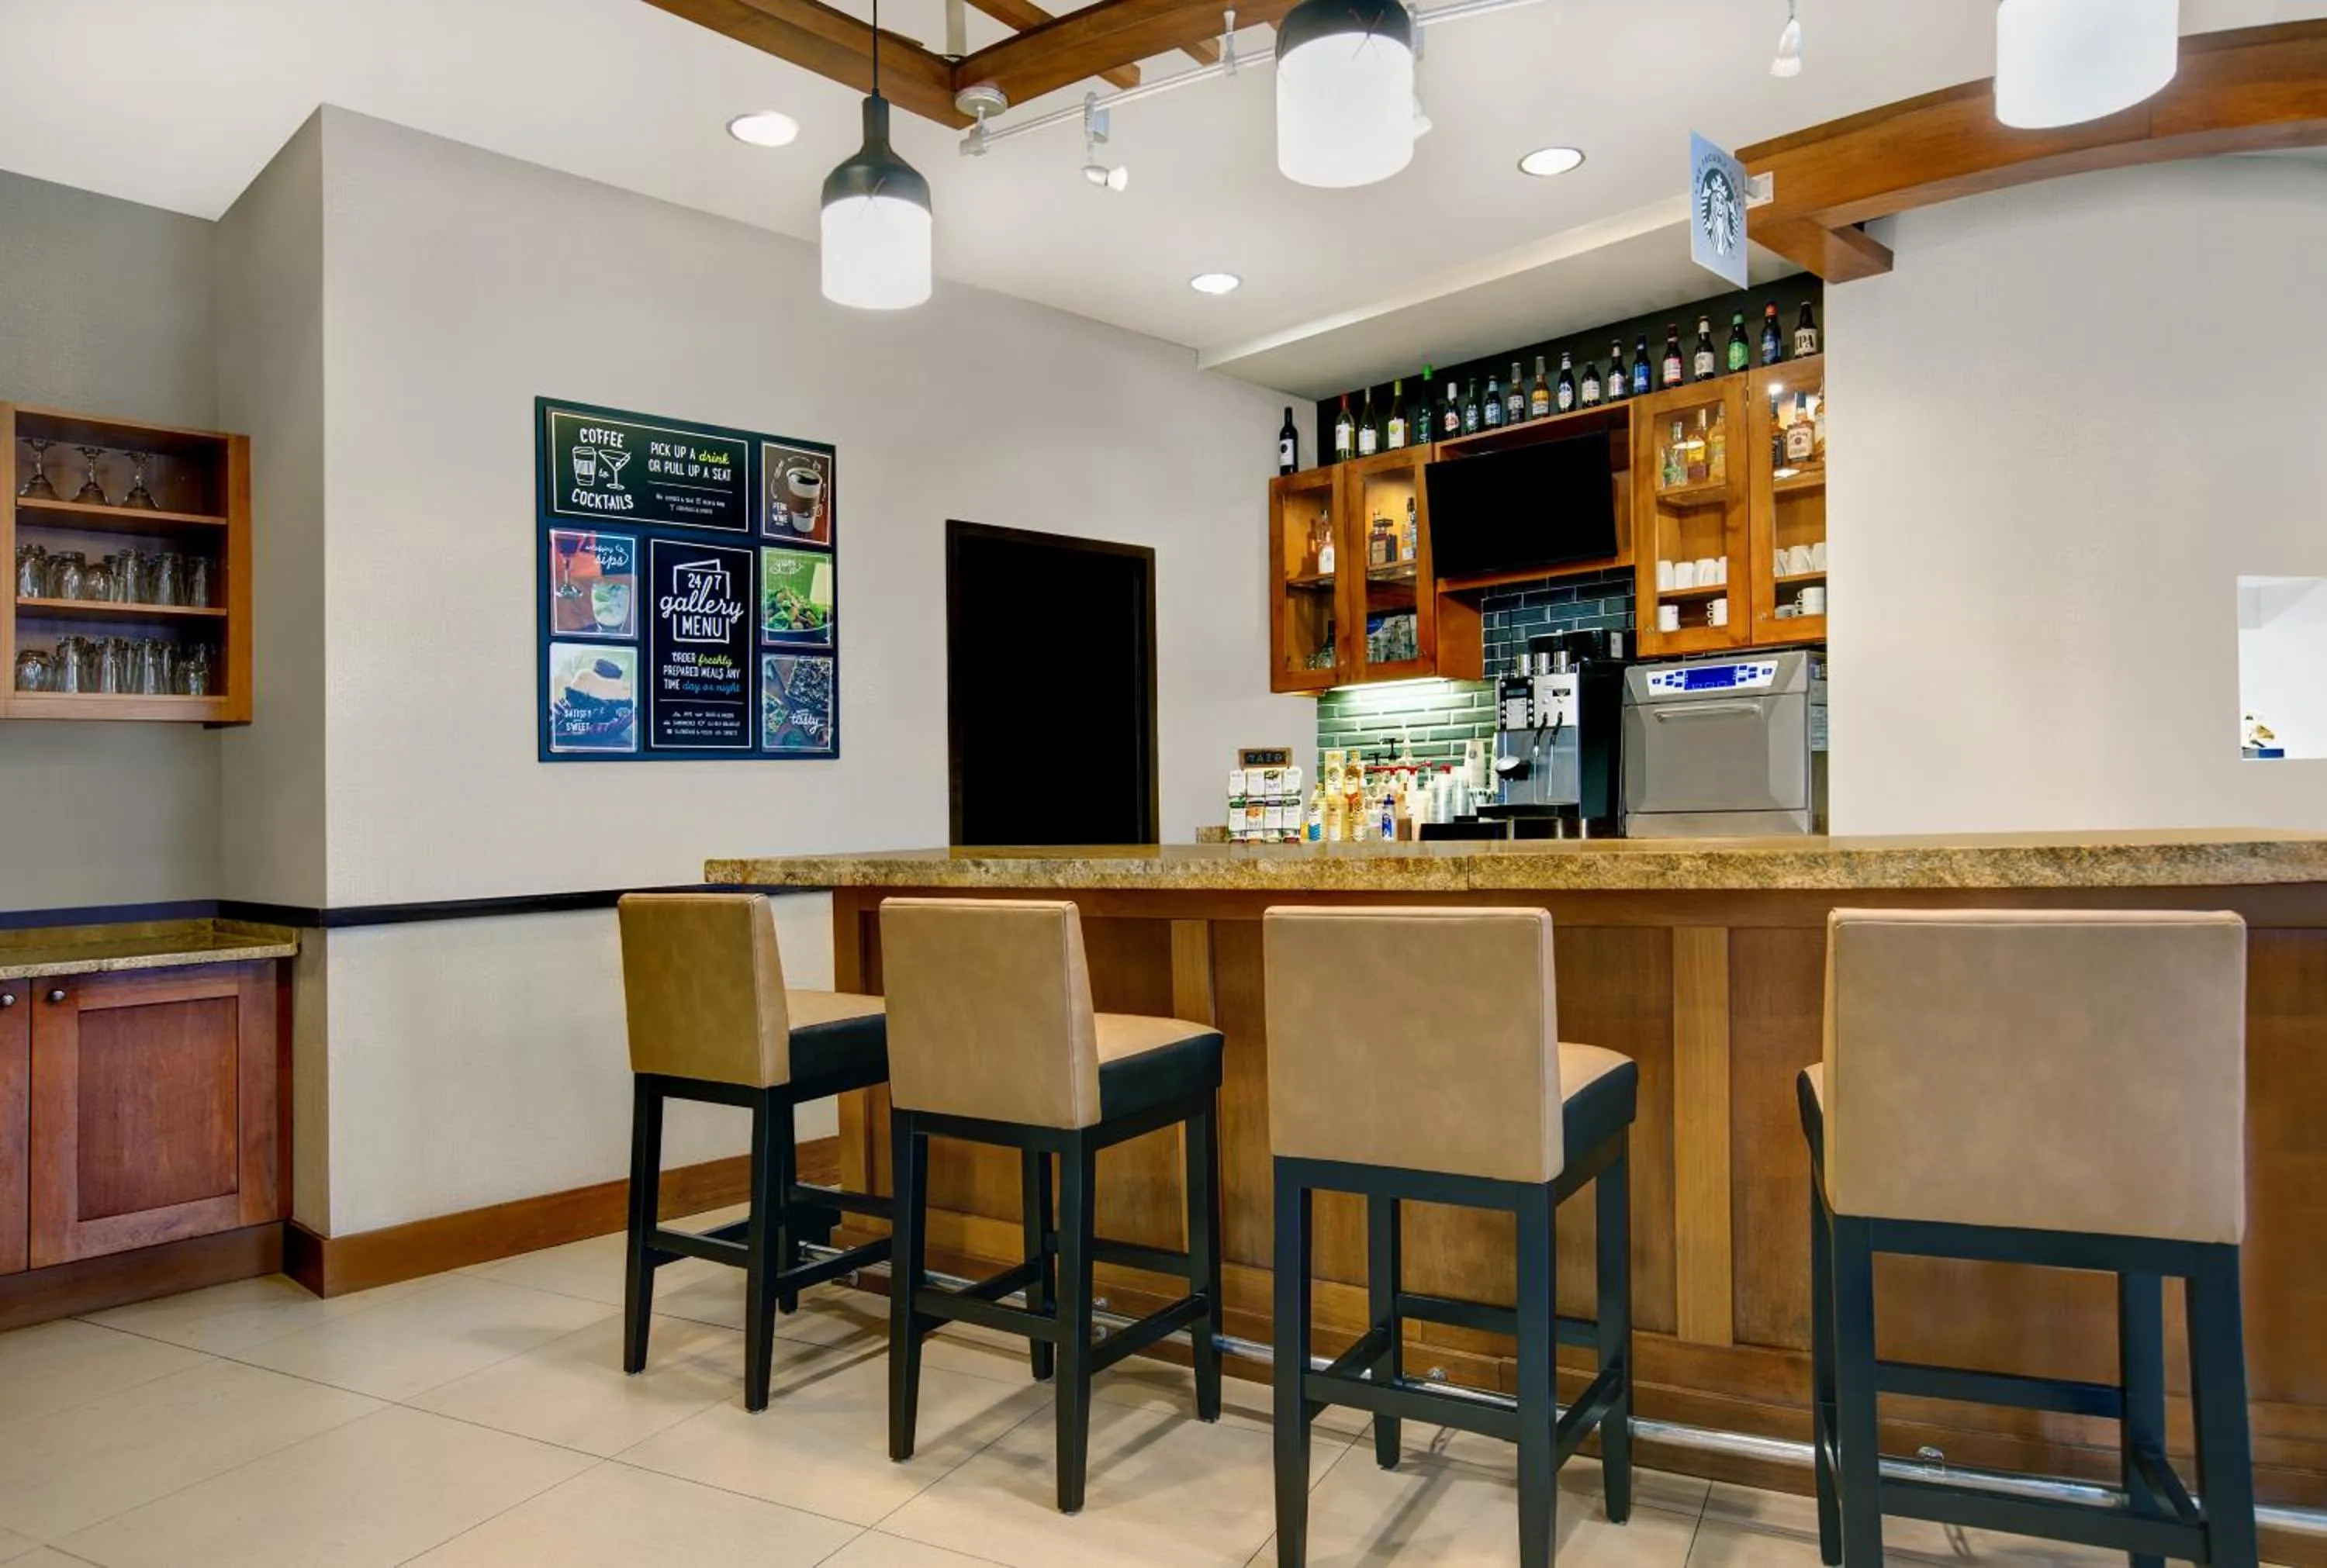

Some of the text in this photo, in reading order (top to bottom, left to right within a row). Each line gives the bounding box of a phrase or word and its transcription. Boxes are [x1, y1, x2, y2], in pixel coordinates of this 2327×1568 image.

[579, 427, 624, 448] COFFEE
[651, 441, 730, 465] PICK UP A drink
[648, 458, 731, 482] OR PULL UP A SEAT
[572, 488, 634, 511] COCKTAILS
[659, 575, 745, 624] gallery
[682, 615, 722, 637] MENU
[672, 651, 732, 668] ORDER freshly
[663, 665, 741, 679] PREPARED MEALS ANY
[664, 679, 680, 690] TIME
